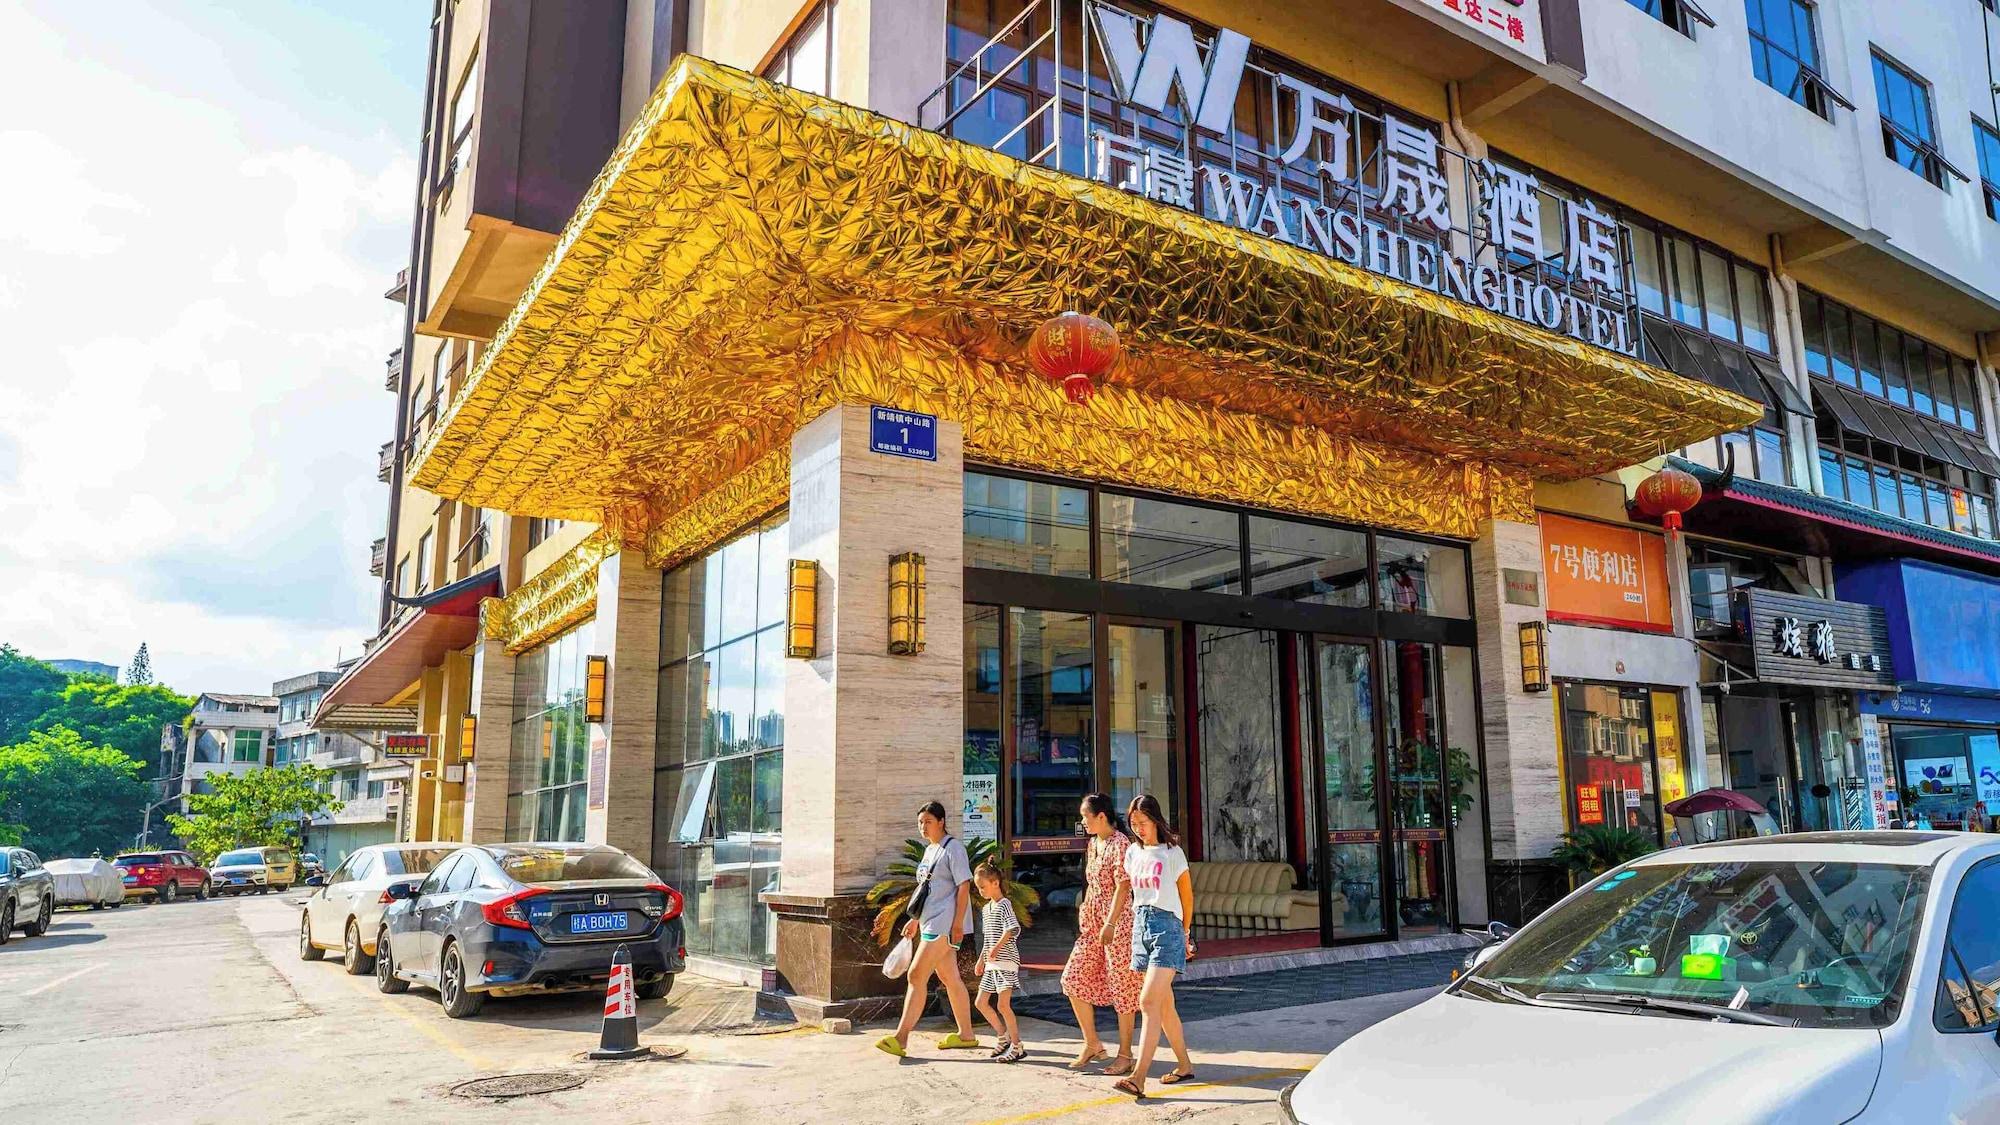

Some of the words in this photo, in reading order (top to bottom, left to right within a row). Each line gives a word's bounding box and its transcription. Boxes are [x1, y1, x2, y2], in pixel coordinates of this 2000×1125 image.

[1095, 129, 1195, 211] 万晟
[1276, 72, 1617, 293] 万晟酒店
[877, 411, 930, 428] 新靖镇中山路
[900, 428, 909, 445] 1
[1550, 543, 1638, 588] 7号便利店
